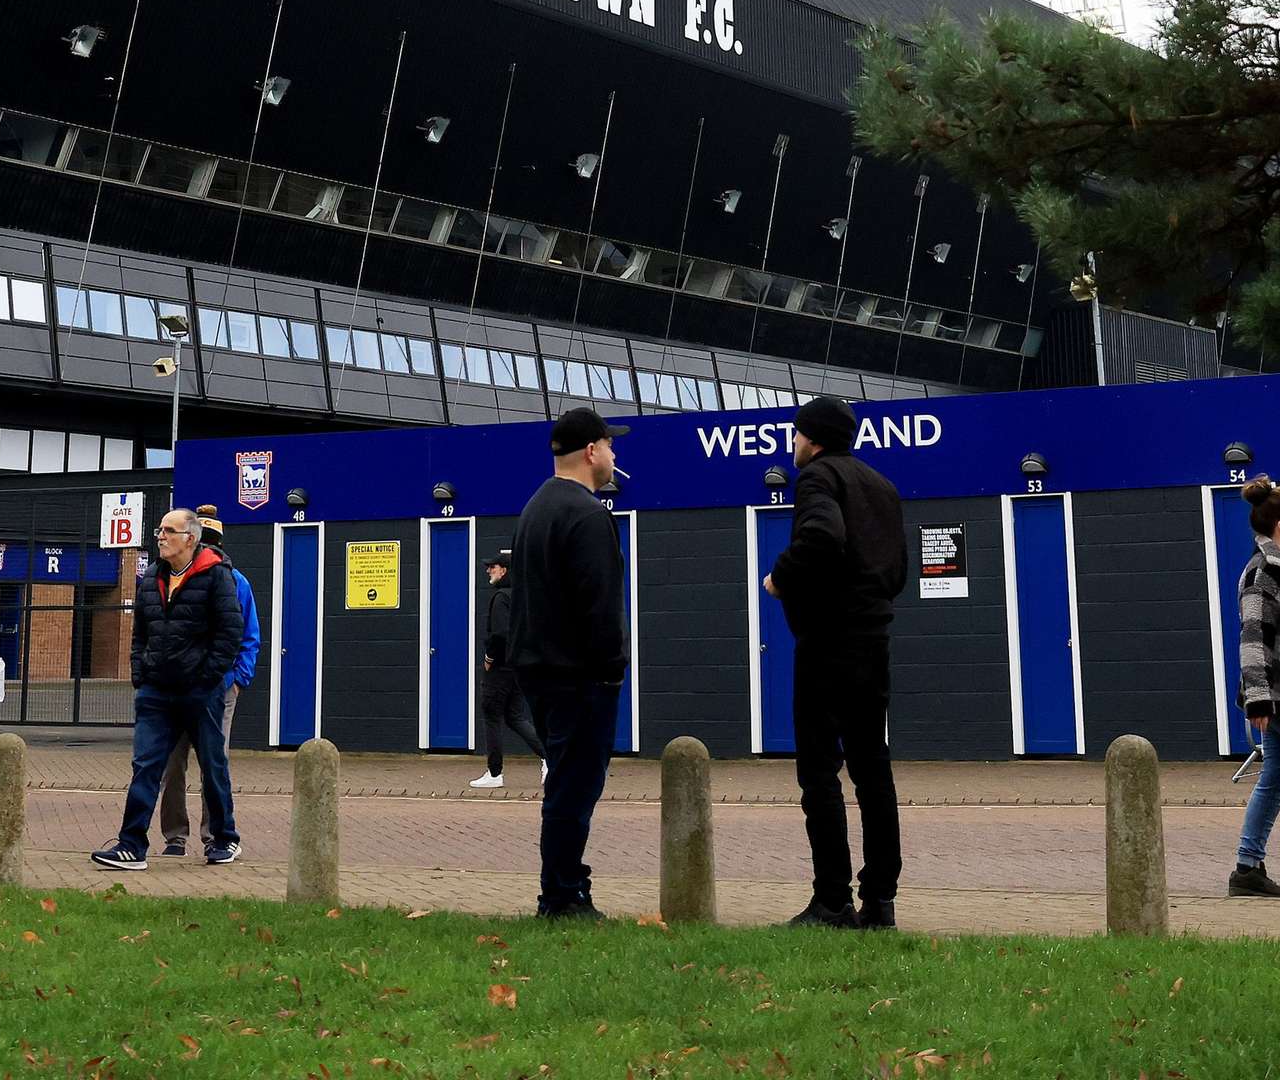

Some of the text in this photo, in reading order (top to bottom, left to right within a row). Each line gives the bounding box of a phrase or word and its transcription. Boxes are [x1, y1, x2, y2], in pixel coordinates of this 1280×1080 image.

[697, 415, 941, 457] WEST AND
[1230, 469, 1246, 482] 54
[1028, 479, 1043, 493] 53
[771, 491, 783, 504] 51
[113, 508, 132, 516] GATE
[293, 510, 305, 522] 48
[441, 504, 454, 516] 49
[351, 545, 394, 553] SPECIAL NOTICE
[48, 556, 59, 573] R
